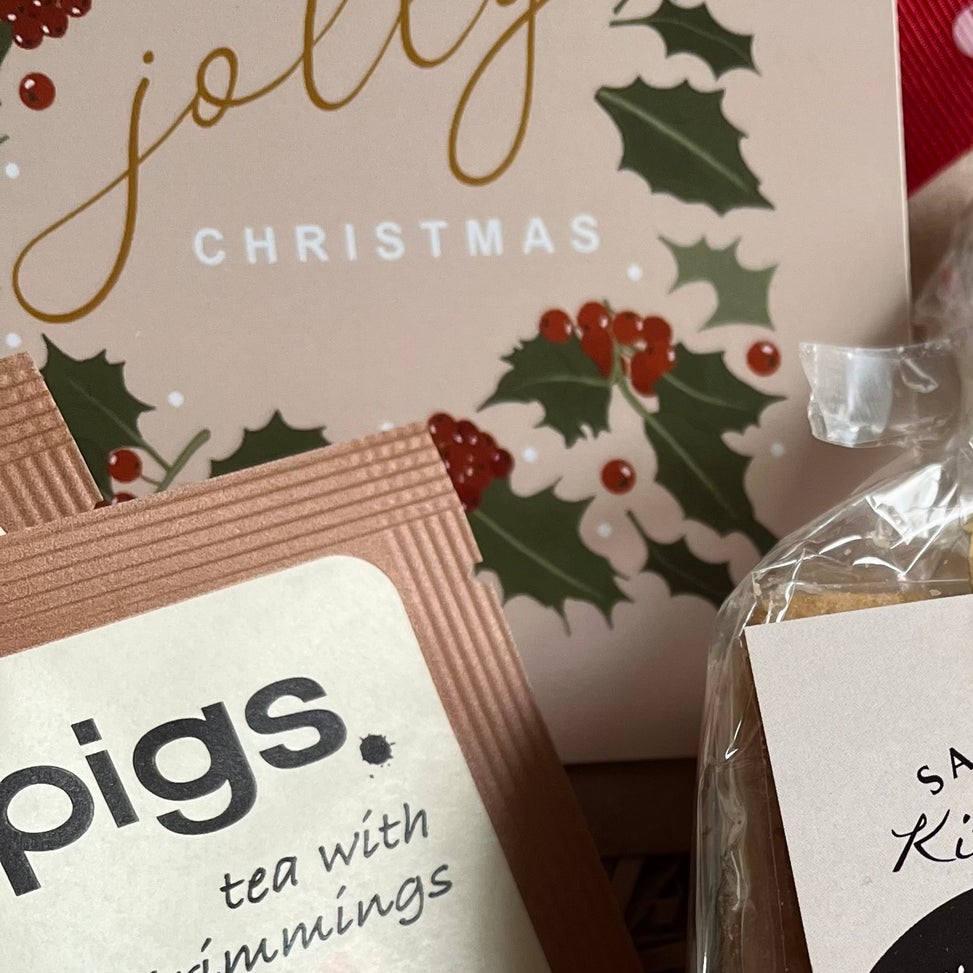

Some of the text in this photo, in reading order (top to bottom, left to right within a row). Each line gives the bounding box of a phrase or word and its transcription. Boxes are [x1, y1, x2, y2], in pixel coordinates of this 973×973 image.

[193, 213, 602, 267] CHRISTMAS
[219, 802, 430, 910] tea with
